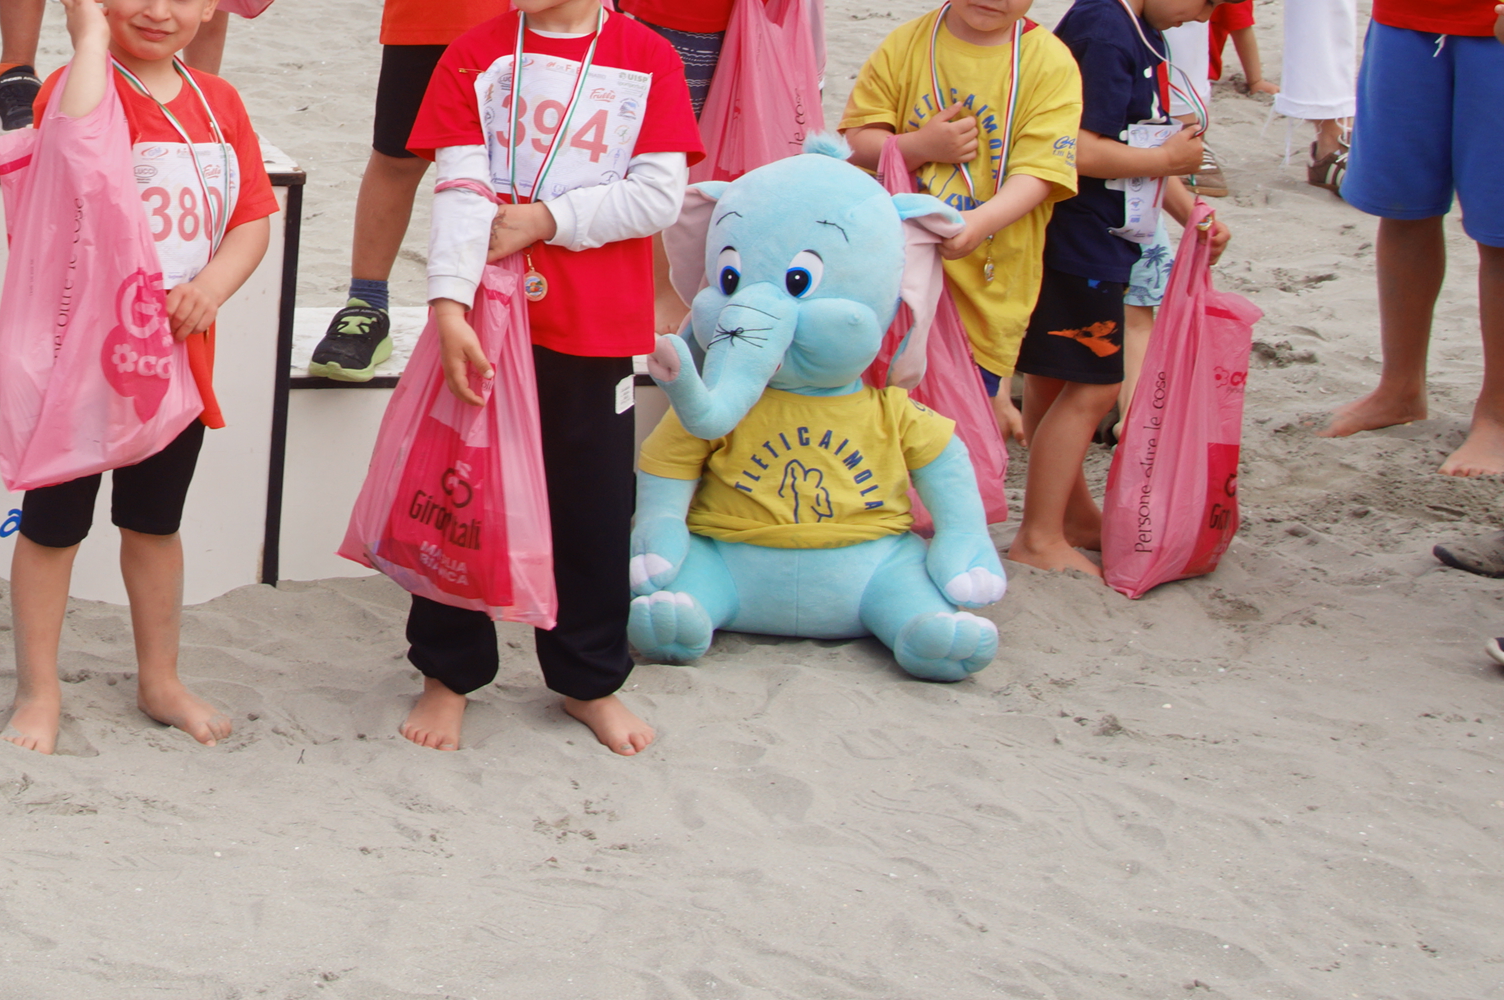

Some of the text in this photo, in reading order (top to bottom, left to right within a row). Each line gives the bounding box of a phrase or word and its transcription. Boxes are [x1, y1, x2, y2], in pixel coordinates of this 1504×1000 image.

[496, 93, 609, 164] 394
[141, 186, 223, 242] 380
[1154, 371, 1166, 411] cose
[1144, 416, 1162, 431] le
[1135, 483, 1153, 555] Persone
